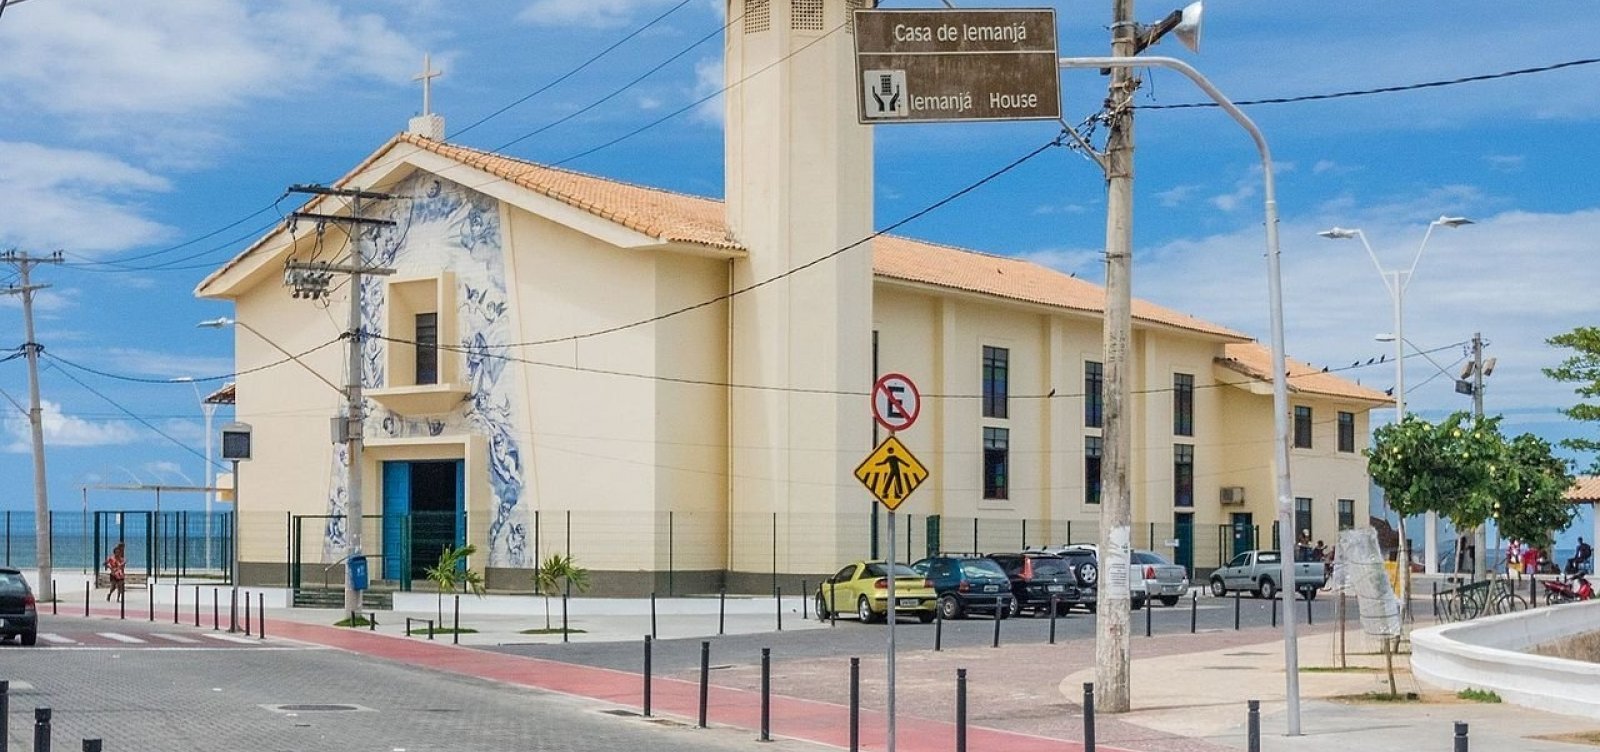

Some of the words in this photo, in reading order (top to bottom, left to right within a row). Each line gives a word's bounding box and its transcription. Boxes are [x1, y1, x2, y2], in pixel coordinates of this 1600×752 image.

[895, 24, 932, 42] Casa
[937, 24, 958, 42] de
[963, 22, 1026, 43] Iemanjá
[910, 92, 972, 112] Iemanjá
[989, 92, 1037, 109] House
[887, 386, 905, 418] E
